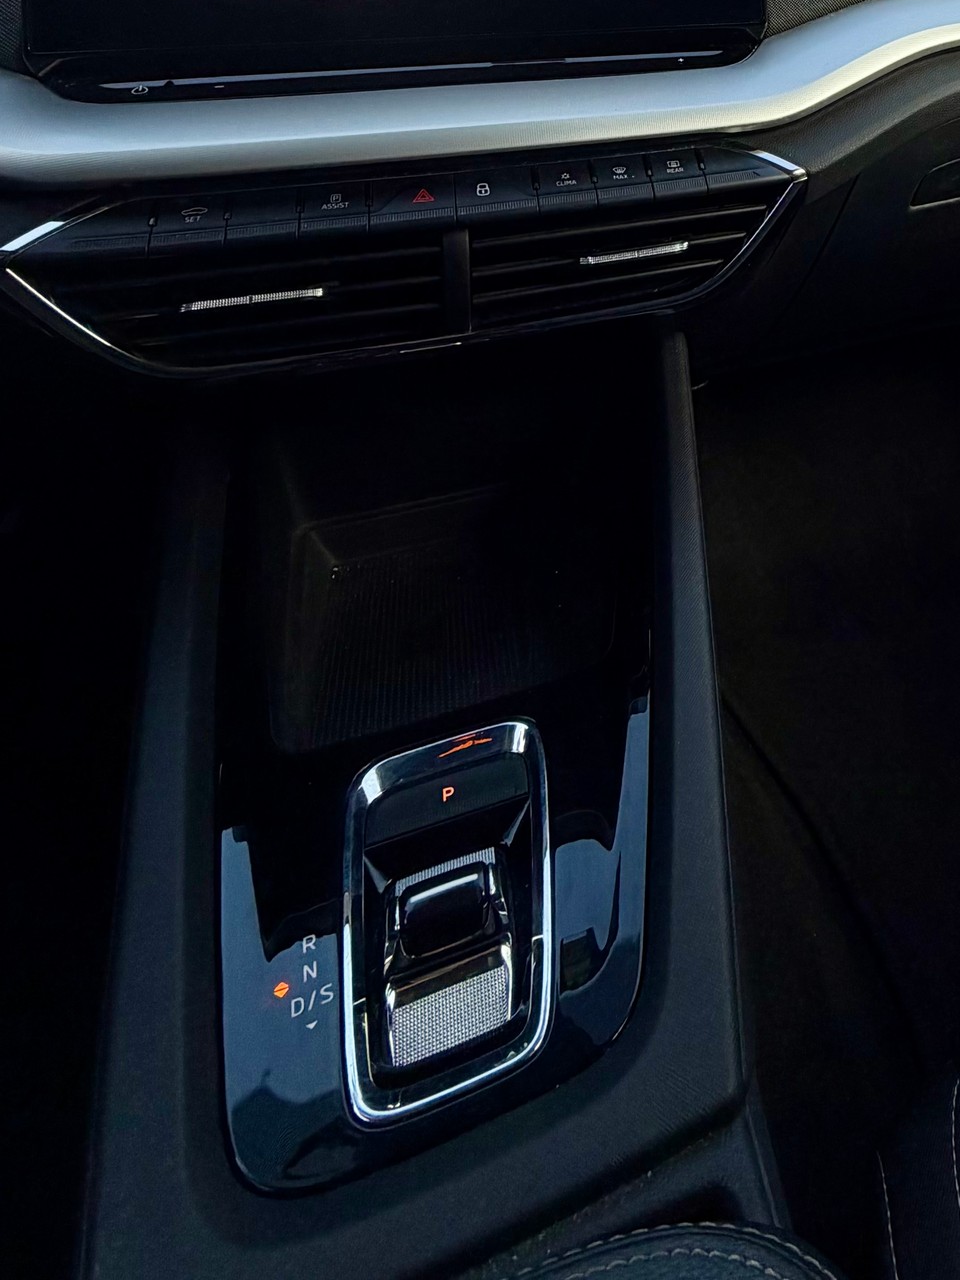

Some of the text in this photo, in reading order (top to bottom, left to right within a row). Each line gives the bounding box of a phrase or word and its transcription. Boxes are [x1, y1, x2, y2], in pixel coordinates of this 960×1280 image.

[556, 178, 578, 187] CLIMA
[321, 201, 350, 211] ASSIST
[442, 786, 455, 803] P
[303, 934, 317, 956] R
[303, 960, 318, 984] N
[290, 983, 335, 1019] D/S
